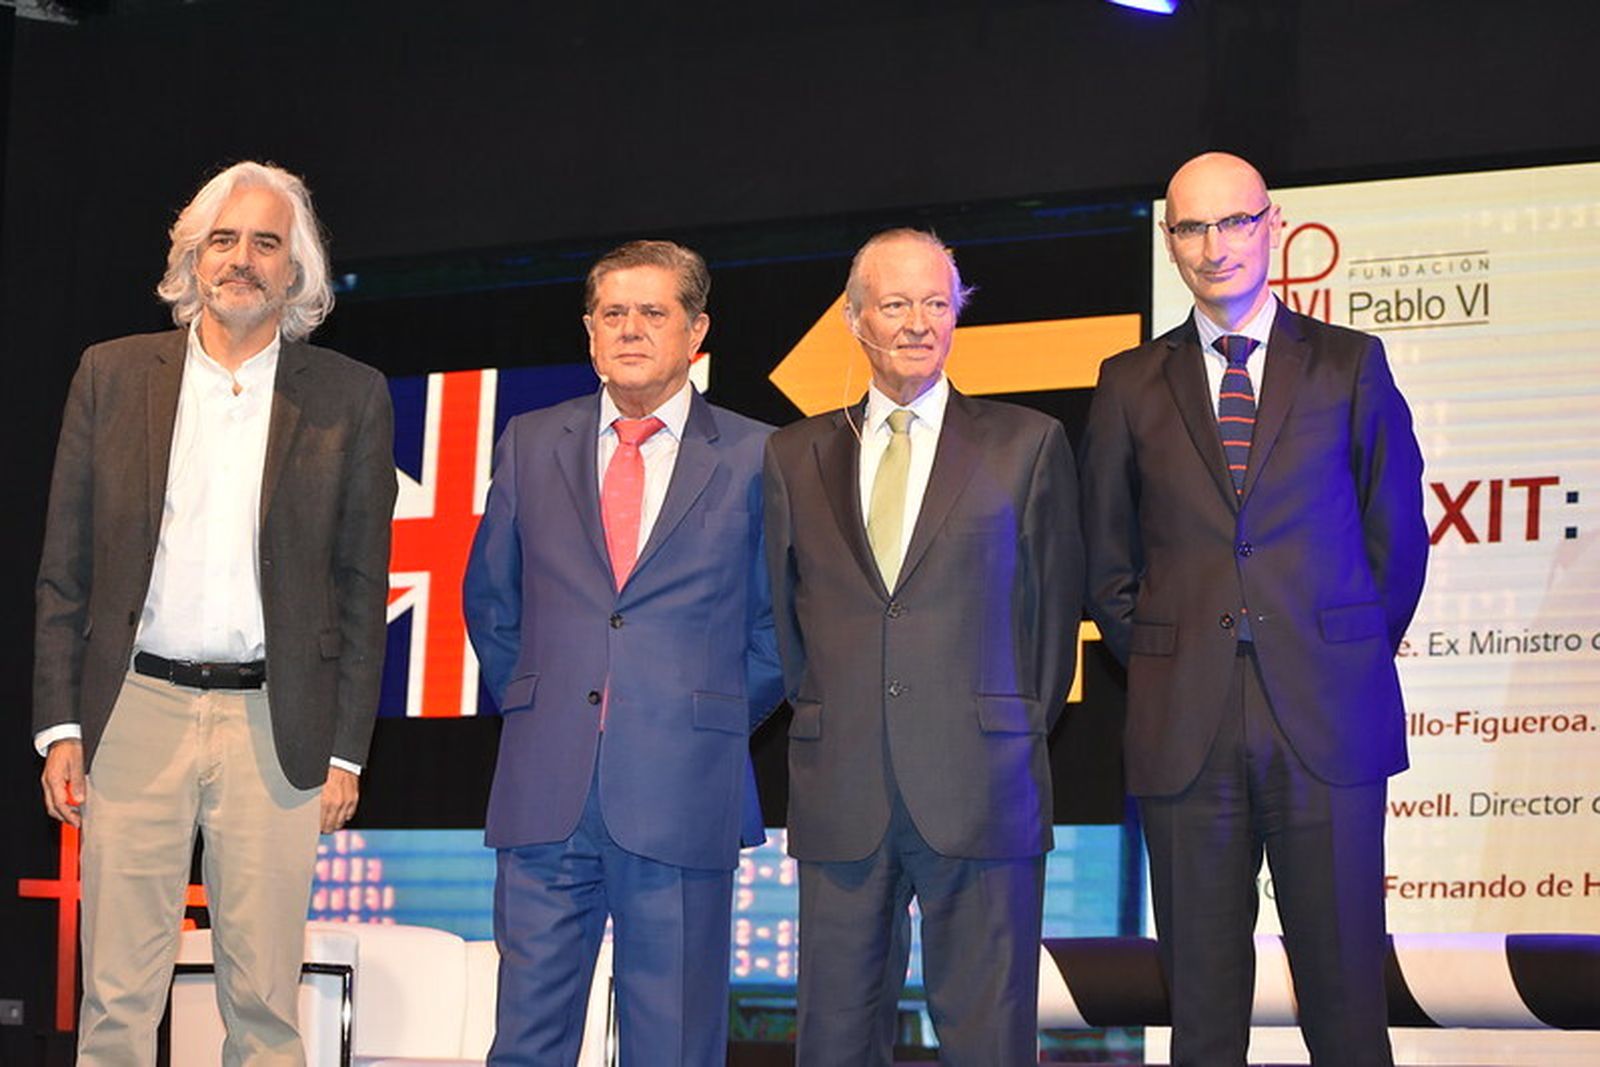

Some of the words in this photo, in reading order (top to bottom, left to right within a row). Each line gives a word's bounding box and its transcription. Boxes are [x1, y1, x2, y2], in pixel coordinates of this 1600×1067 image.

[1347, 257, 1491, 280] FUNDACIÓN
[1349, 287, 1446, 325] Pablo
[1455, 282, 1490, 318] VI
[1428, 631, 1461, 657] Ex
[1468, 627, 1582, 656] Ministro
[1405, 710, 1597, 743] llo-Figueroa.
[1385, 793, 1459, 818] well.
[1469, 791, 1584, 817] Director
[1384, 873, 1527, 899] Fernando
[1535, 872, 1574, 898] de
